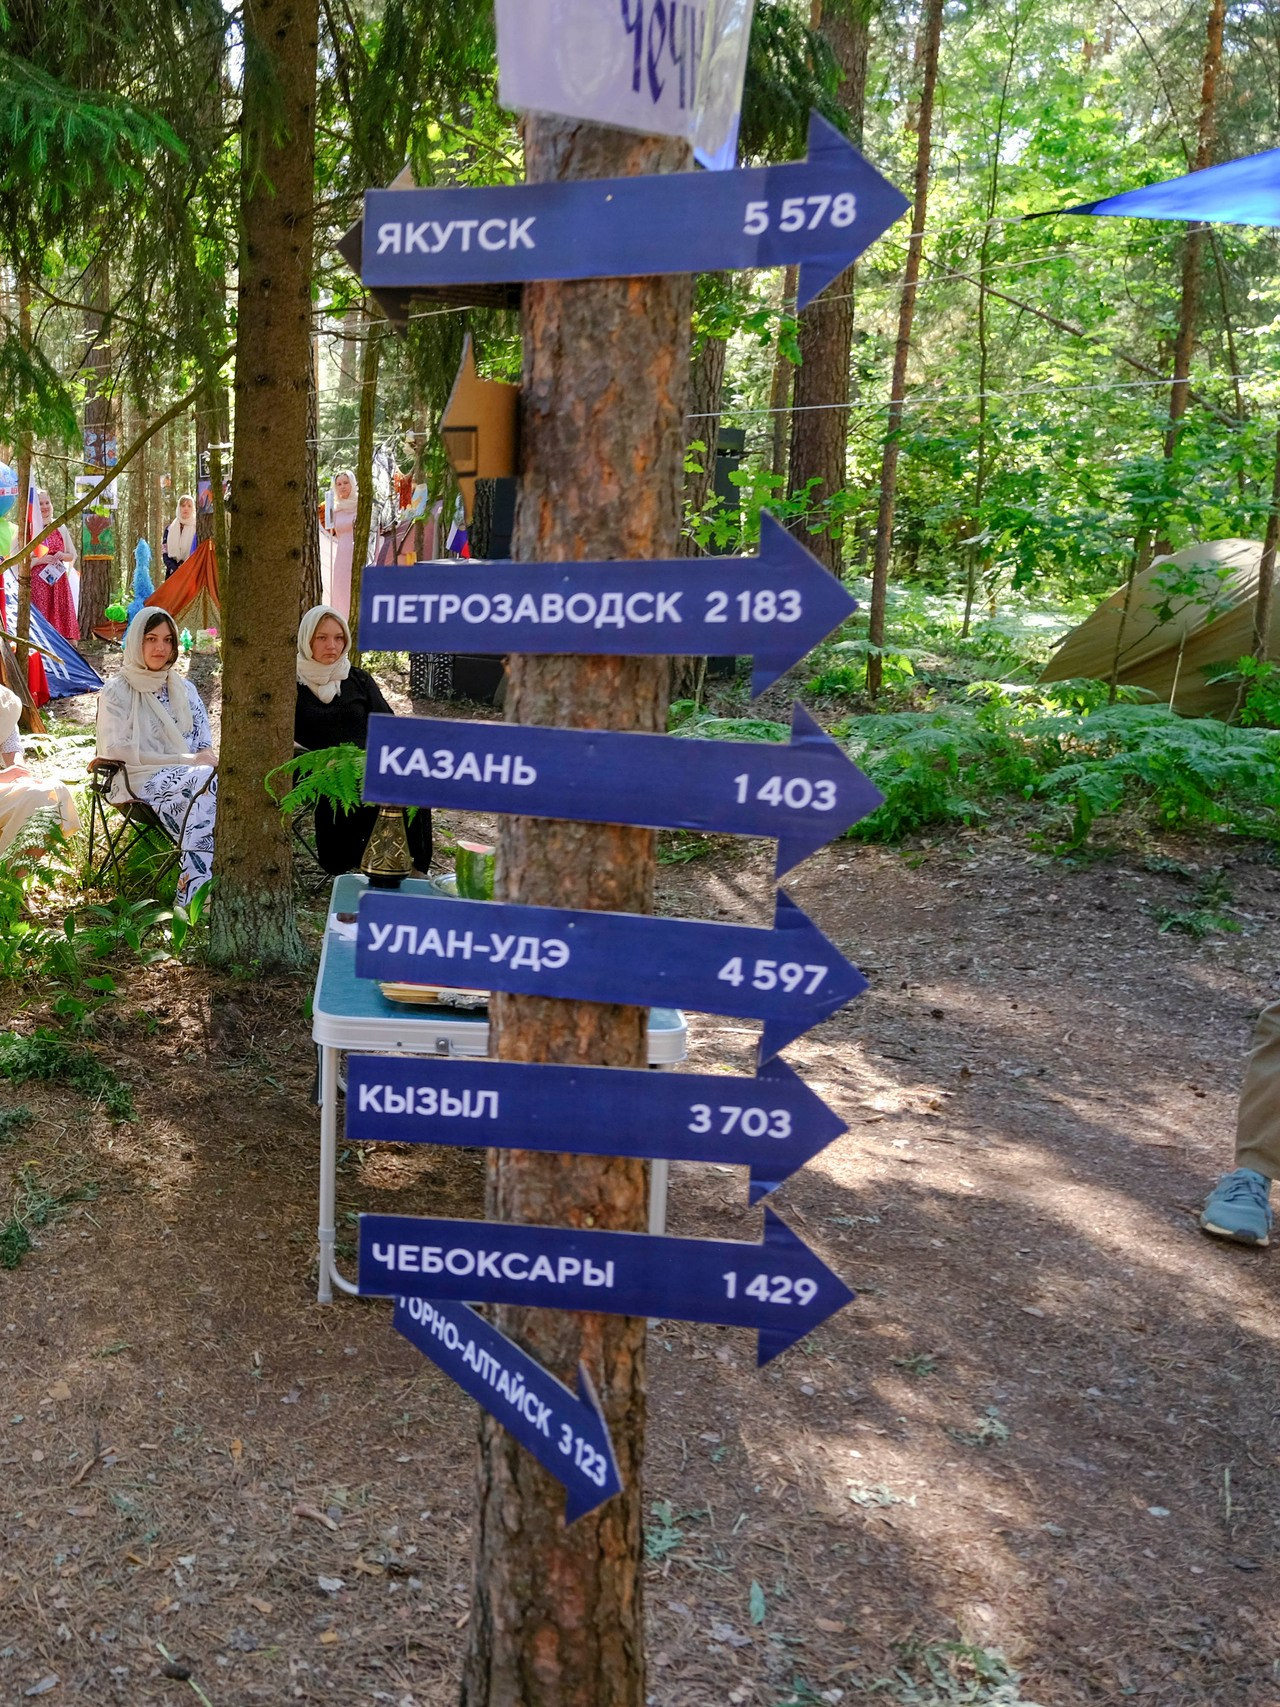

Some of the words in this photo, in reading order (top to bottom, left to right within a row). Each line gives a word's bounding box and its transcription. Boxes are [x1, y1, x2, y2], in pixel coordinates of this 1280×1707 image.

[376, 216, 536, 255] ЯКУТСК
[371, 591, 683, 629] ПЕТРОЗАВОДСК
[378, 744, 537, 786] КАЗАНЬ
[367, 922, 570, 972] УЛАН-УДЭ
[358, 1083, 499, 1119] КЫЗЫЛ
[372, 1242, 615, 1288] ЧЕБОКСАРЫ
